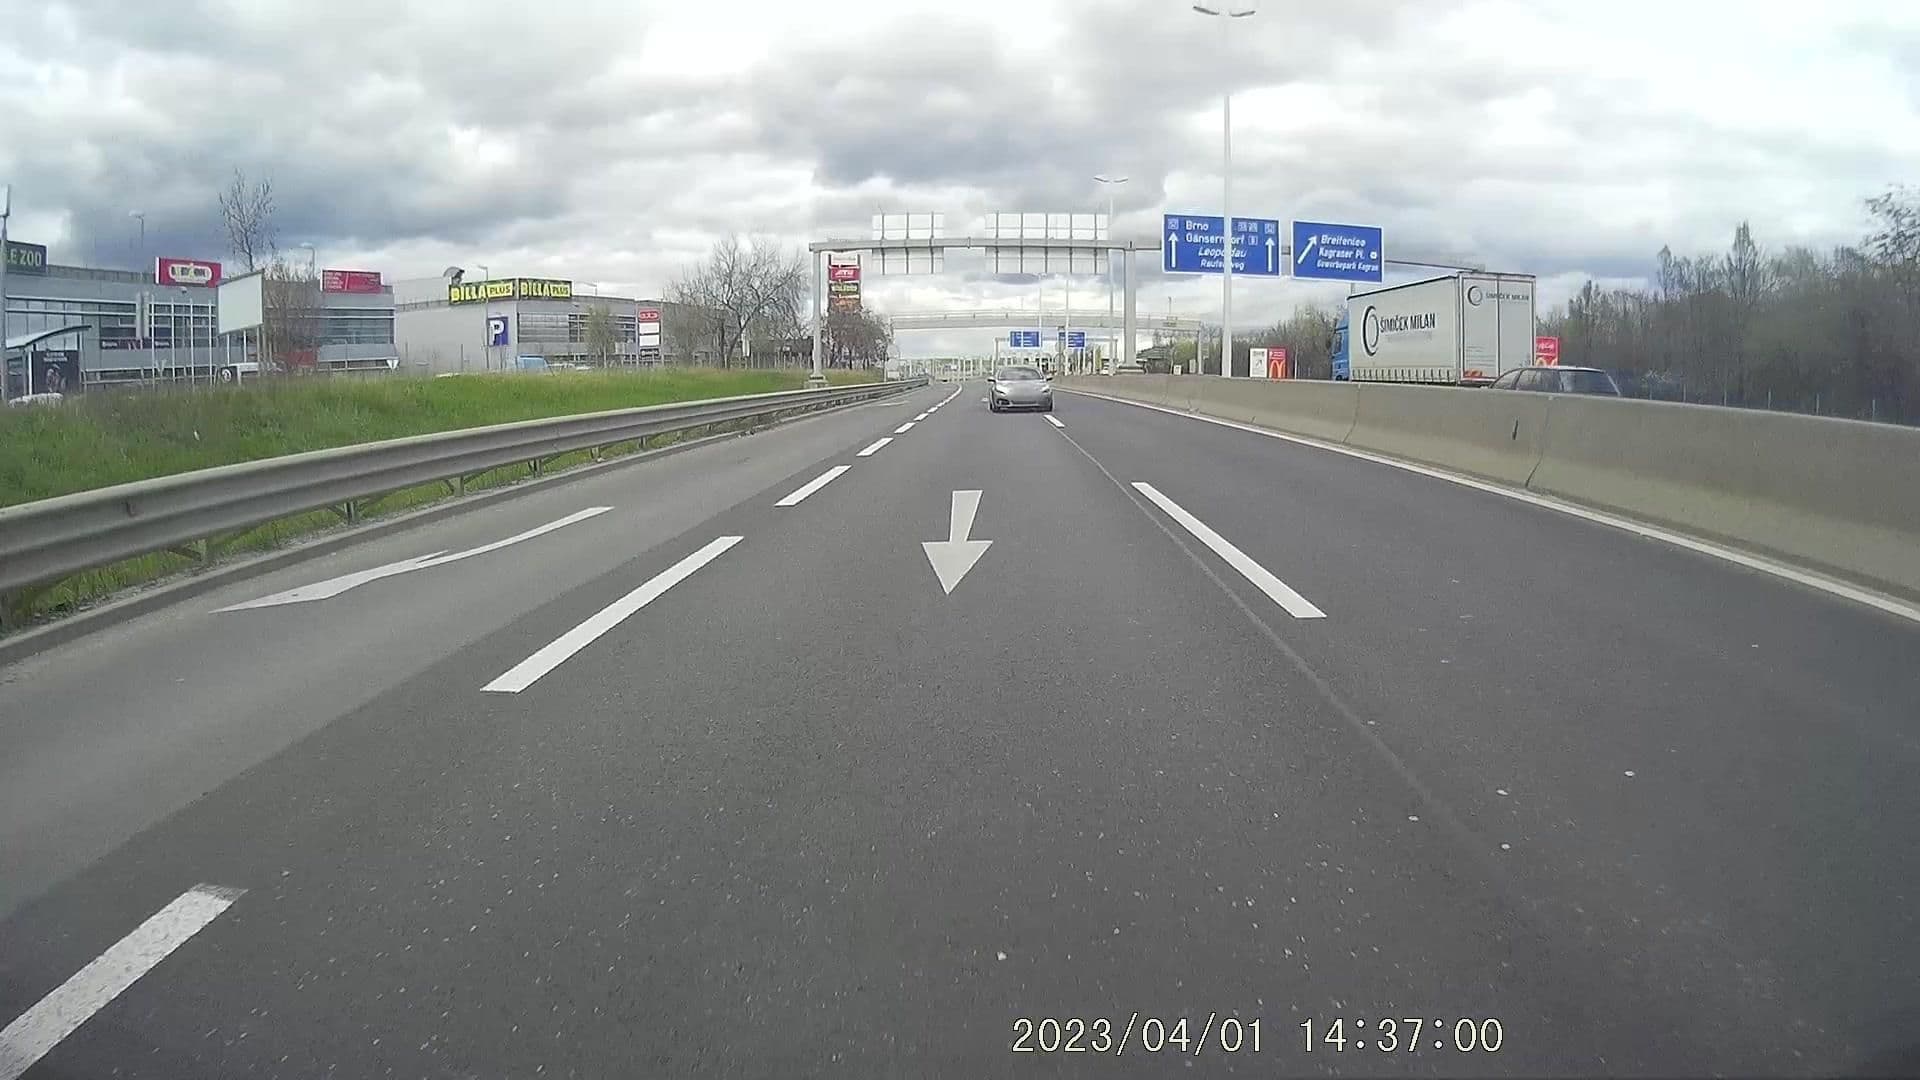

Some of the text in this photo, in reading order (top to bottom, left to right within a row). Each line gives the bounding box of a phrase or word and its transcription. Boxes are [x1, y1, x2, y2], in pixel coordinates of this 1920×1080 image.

[1185, 220, 1209, 231] Brno
[1185, 232, 1245, 245] Gänsernorf
[19, 248, 42, 267] ZOO
[1198, 247, 1248, 259] Leopodau
[450, 284, 512, 301] BILLA PLUS
[520, 281, 569, 297] BILLA PLUS
[1410, 312, 1436, 330] MILAN
[488, 319, 505, 347] P
